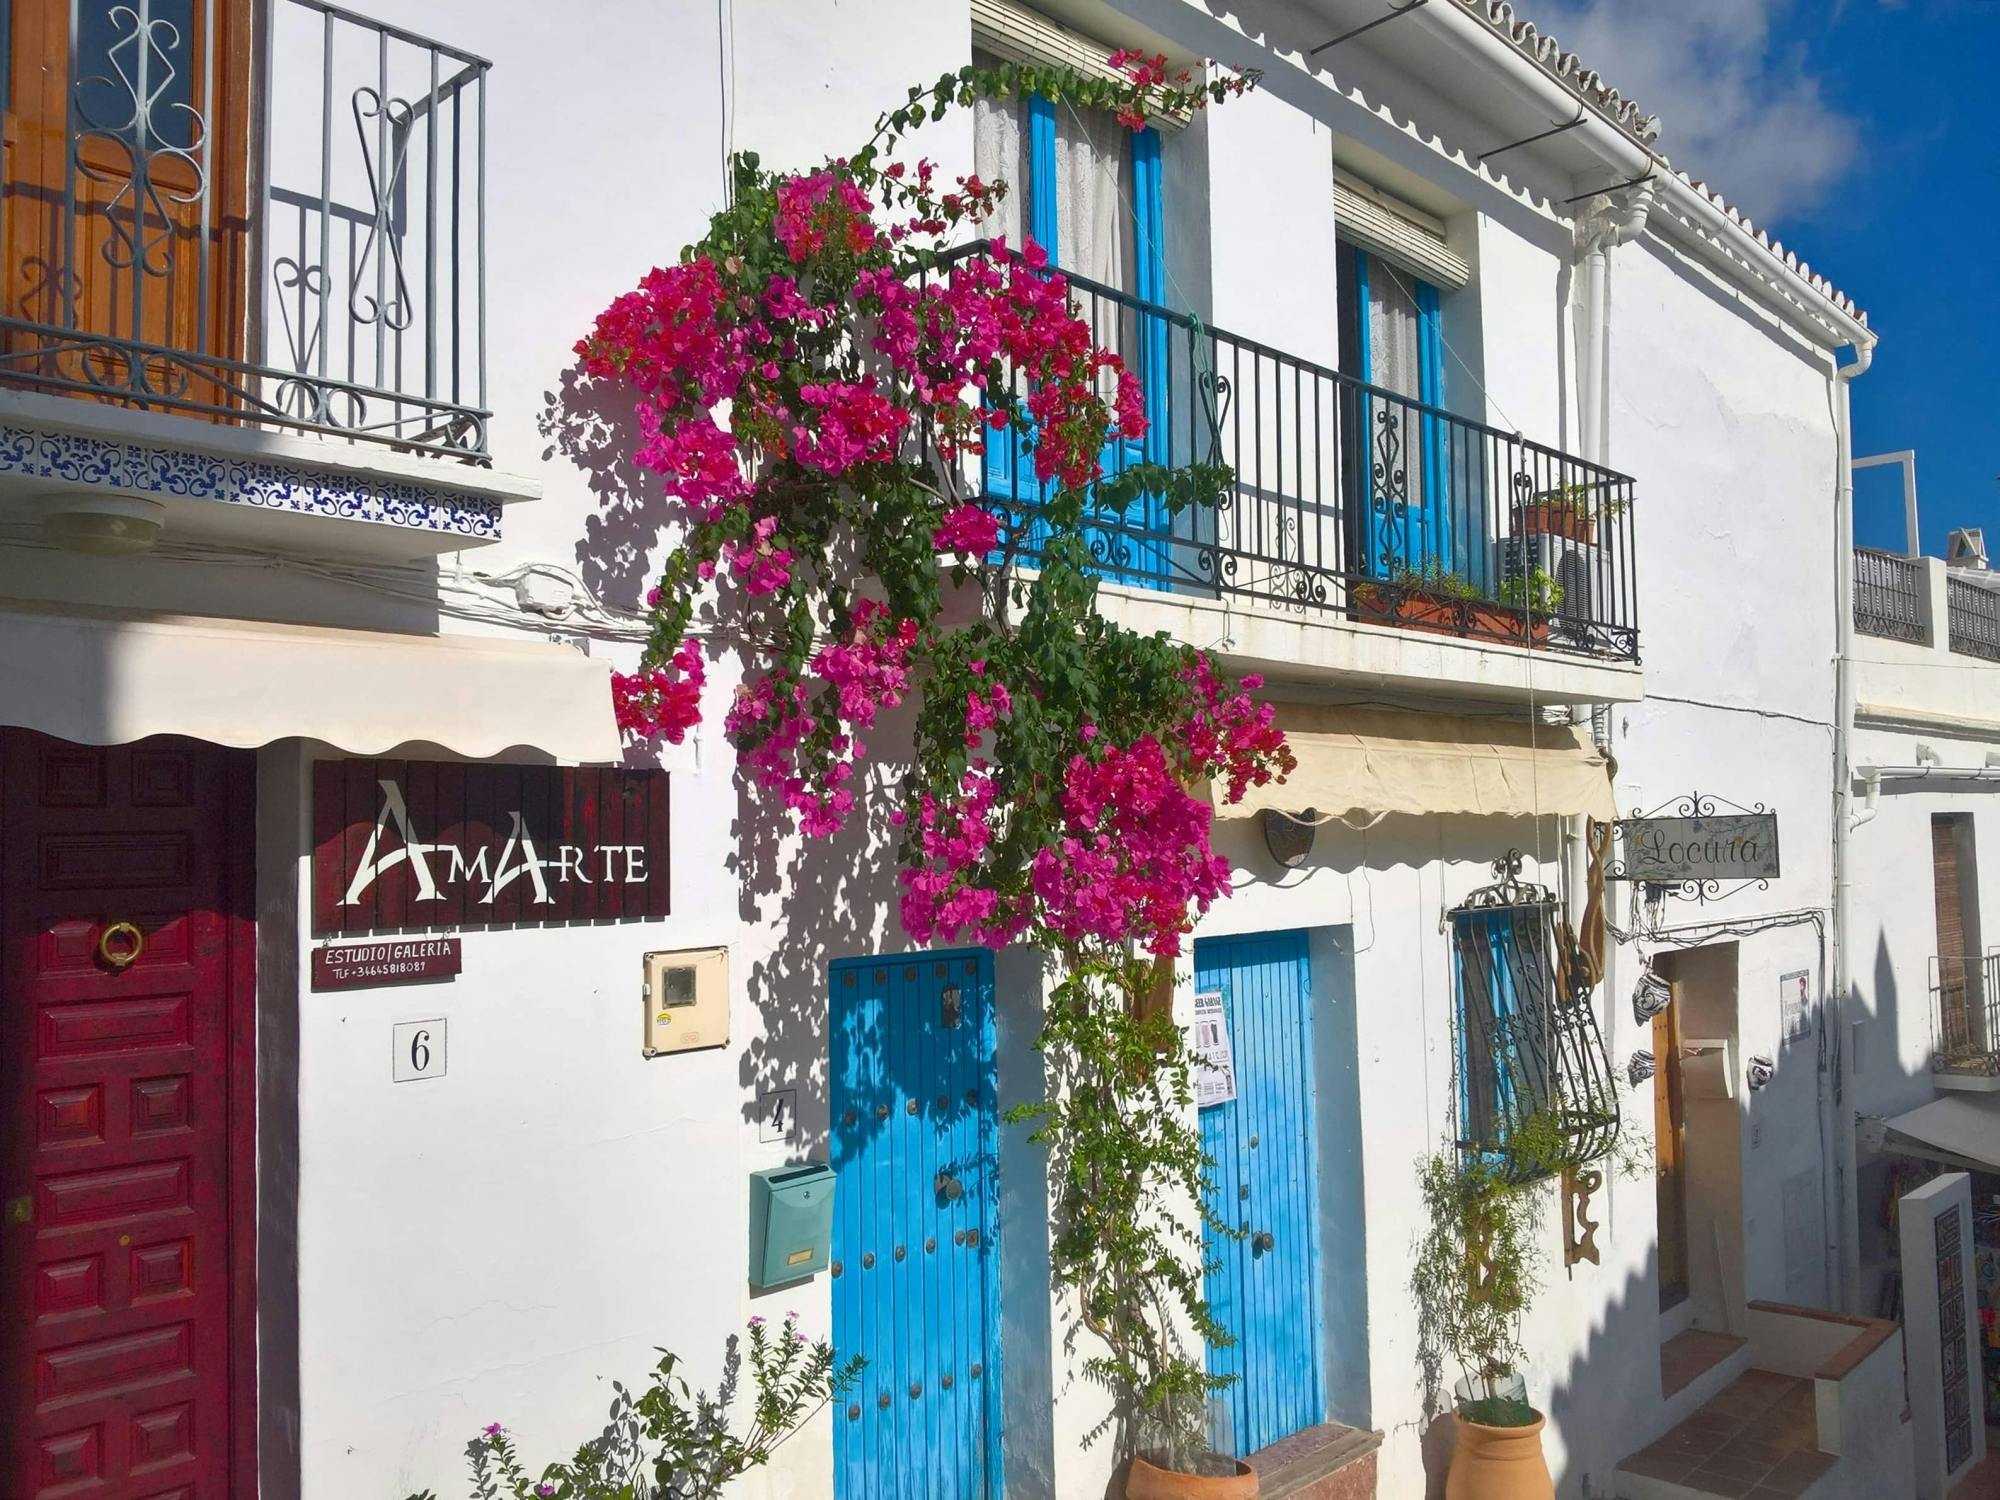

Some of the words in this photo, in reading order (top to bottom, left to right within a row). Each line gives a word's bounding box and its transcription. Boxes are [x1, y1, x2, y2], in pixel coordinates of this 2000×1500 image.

[1640, 828, 1759, 865] Locura
[411, 1029, 430, 1072] 6
[771, 1098, 784, 1133] 4
